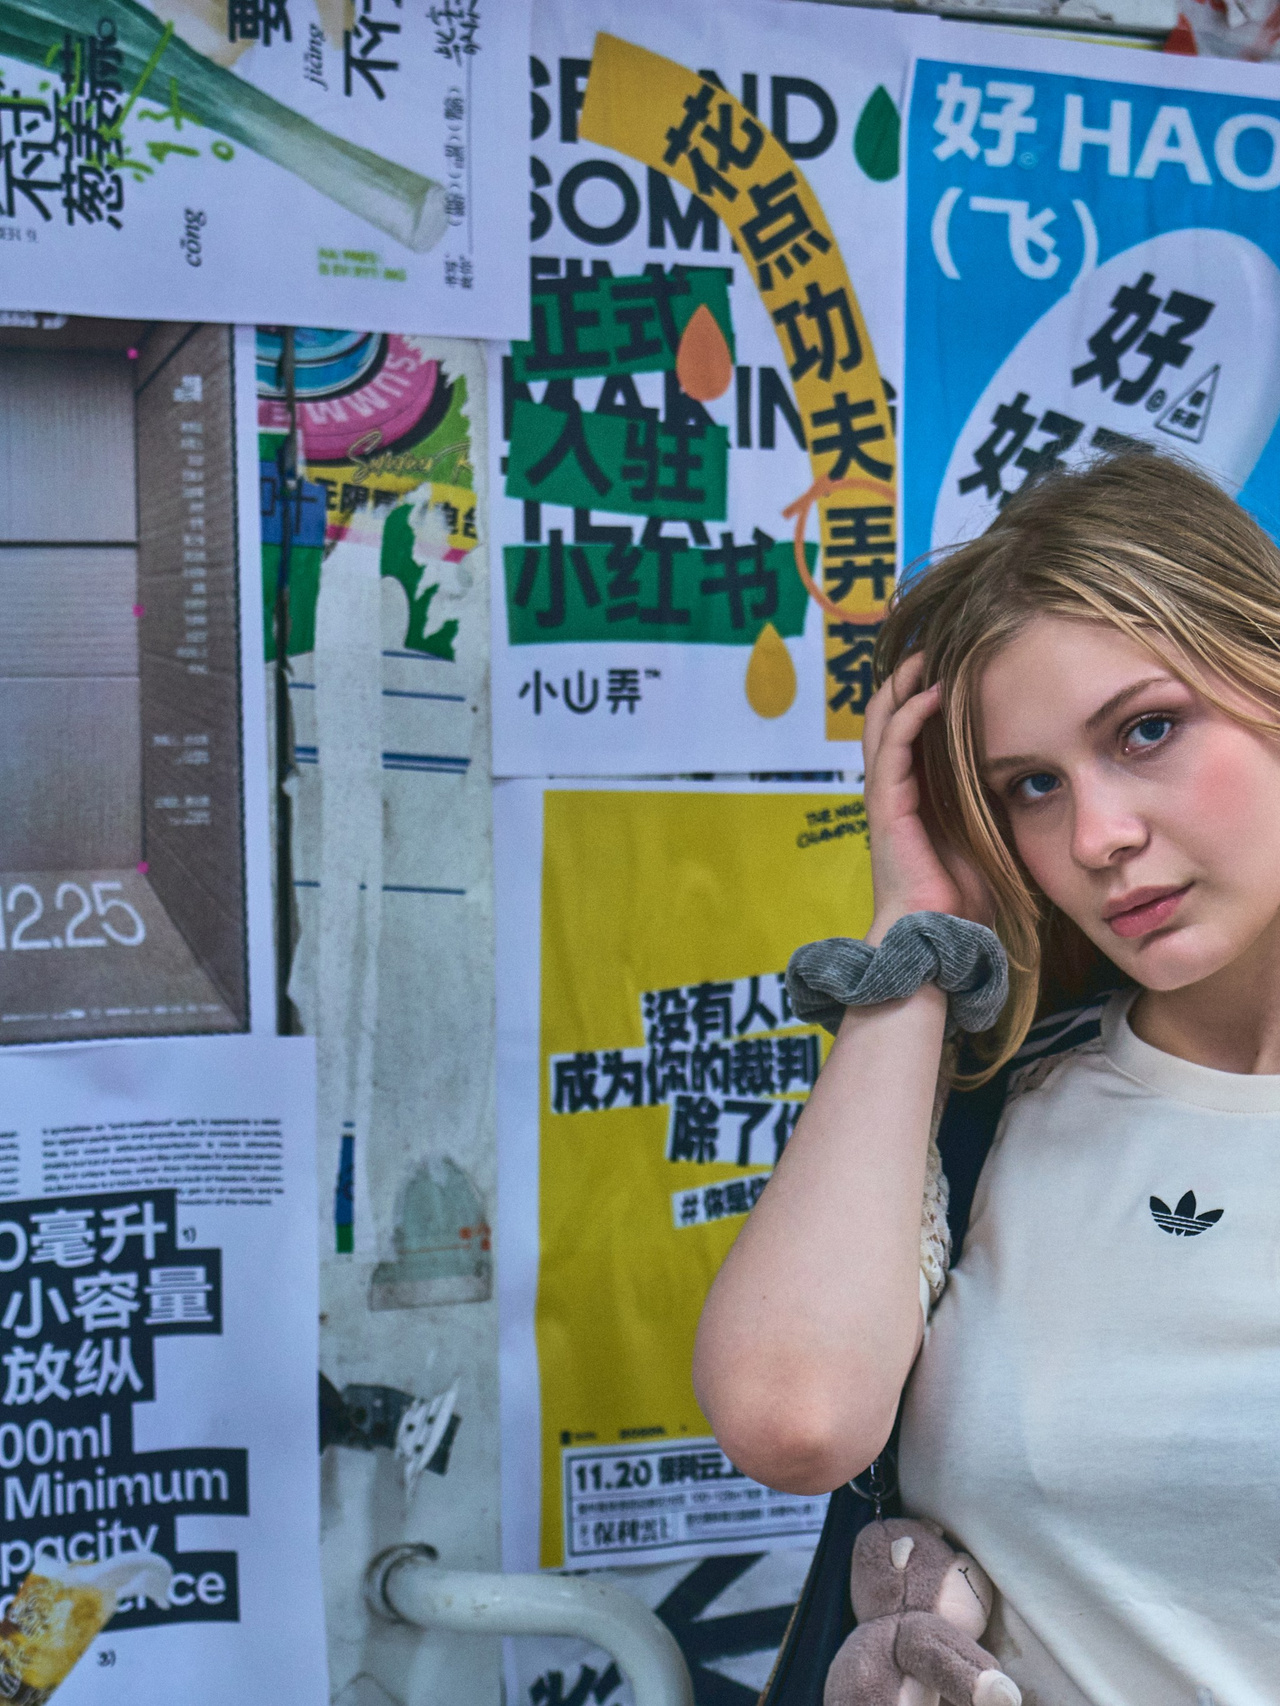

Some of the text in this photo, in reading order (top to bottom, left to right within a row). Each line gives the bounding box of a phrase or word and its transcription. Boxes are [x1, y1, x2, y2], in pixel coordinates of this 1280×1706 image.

[932, 71, 1037, 167] 好
[1071, 272, 1215, 405] 好
[514, 526, 780, 630] 小红书
[643, 971, 810, 1047] 没有人
[554, 1033, 820, 1114] 成为你的裁判
[2, 1265, 214, 1339] 小容量
[4, 1336, 144, 1405] 放纵
[4, 1466, 230, 1521] Minimum
[574, 1460, 653, 1492] 11.20
